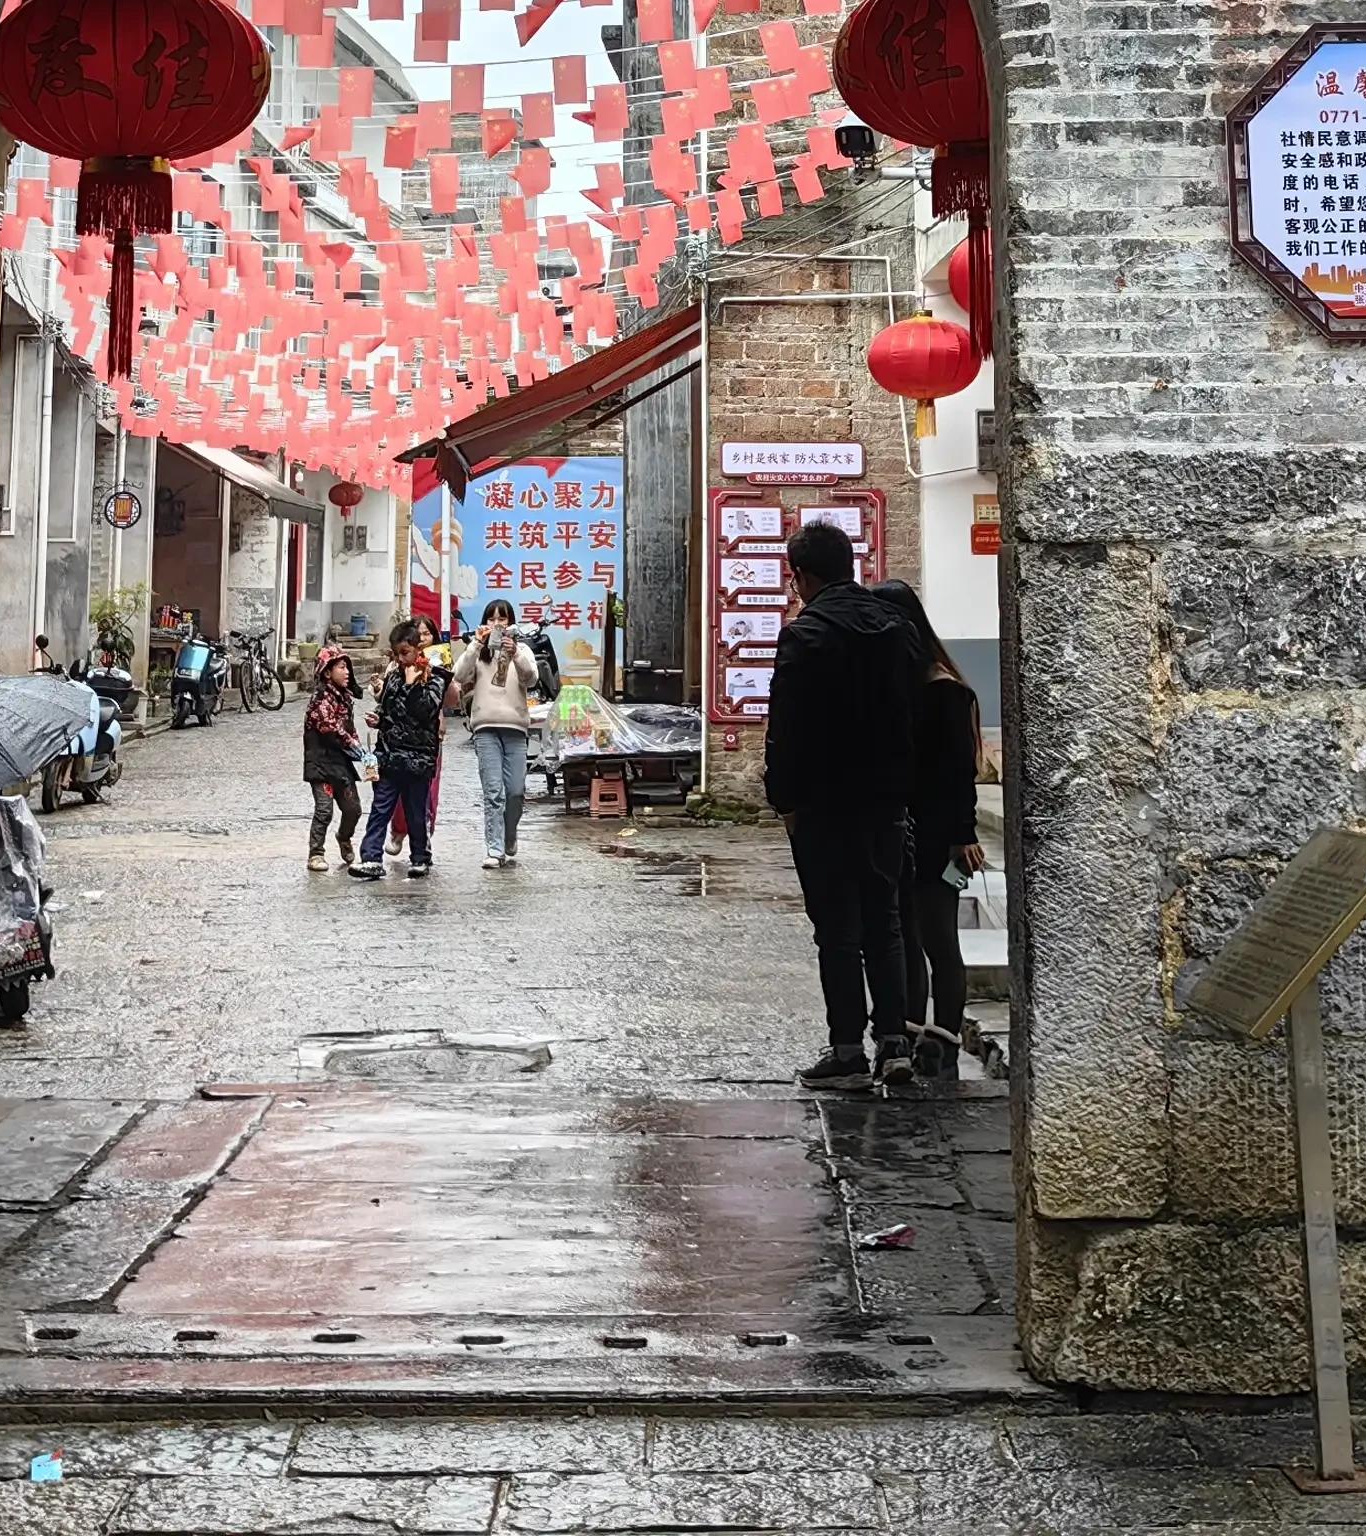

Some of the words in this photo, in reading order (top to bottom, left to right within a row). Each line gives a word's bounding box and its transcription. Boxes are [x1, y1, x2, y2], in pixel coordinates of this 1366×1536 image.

[732, 451, 791, 464] 乡村是我家
[794, 452, 854, 465] 防火靠大家
[484, 481, 617, 510] 凝心聚力
[484, 520, 617, 550] 共筑平安
[484, 561, 617, 590] 全民参与
